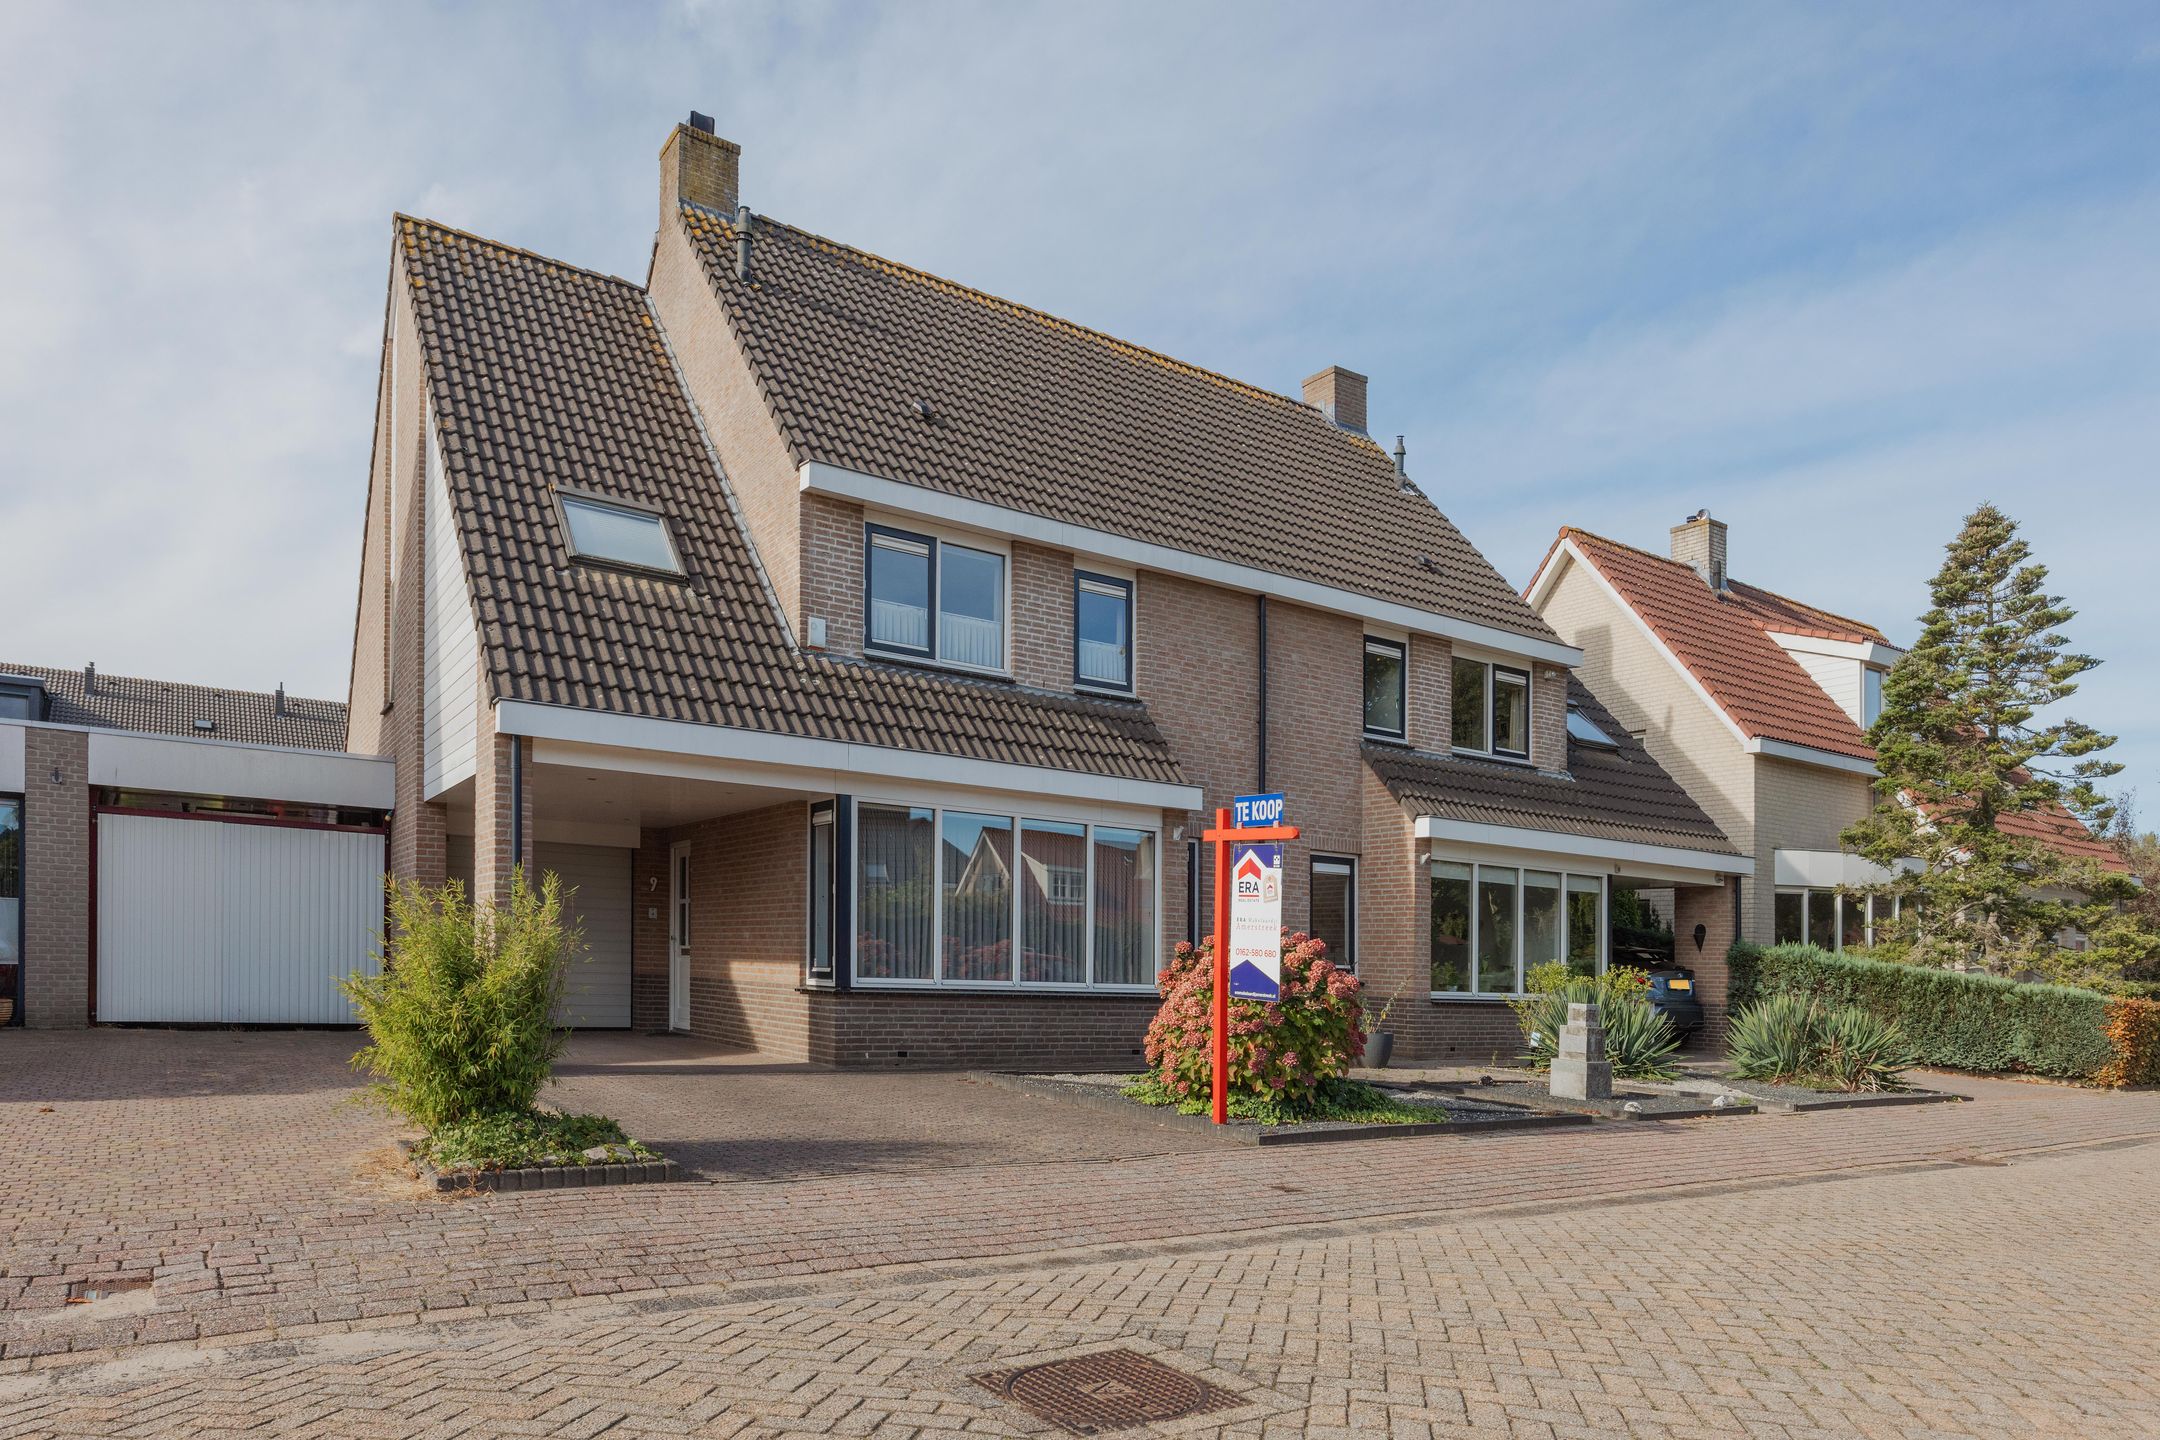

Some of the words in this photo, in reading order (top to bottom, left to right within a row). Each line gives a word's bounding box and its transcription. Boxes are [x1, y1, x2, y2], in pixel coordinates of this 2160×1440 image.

[1235, 802, 1249, 821] TE
[1252, 799, 1283, 820] KOOP
[650, 877, 657, 892] 9
[1238, 881, 1259, 893] ERA
[1235, 948, 1263, 957] 0162-580
[1263, 949, 1277, 958] 680
